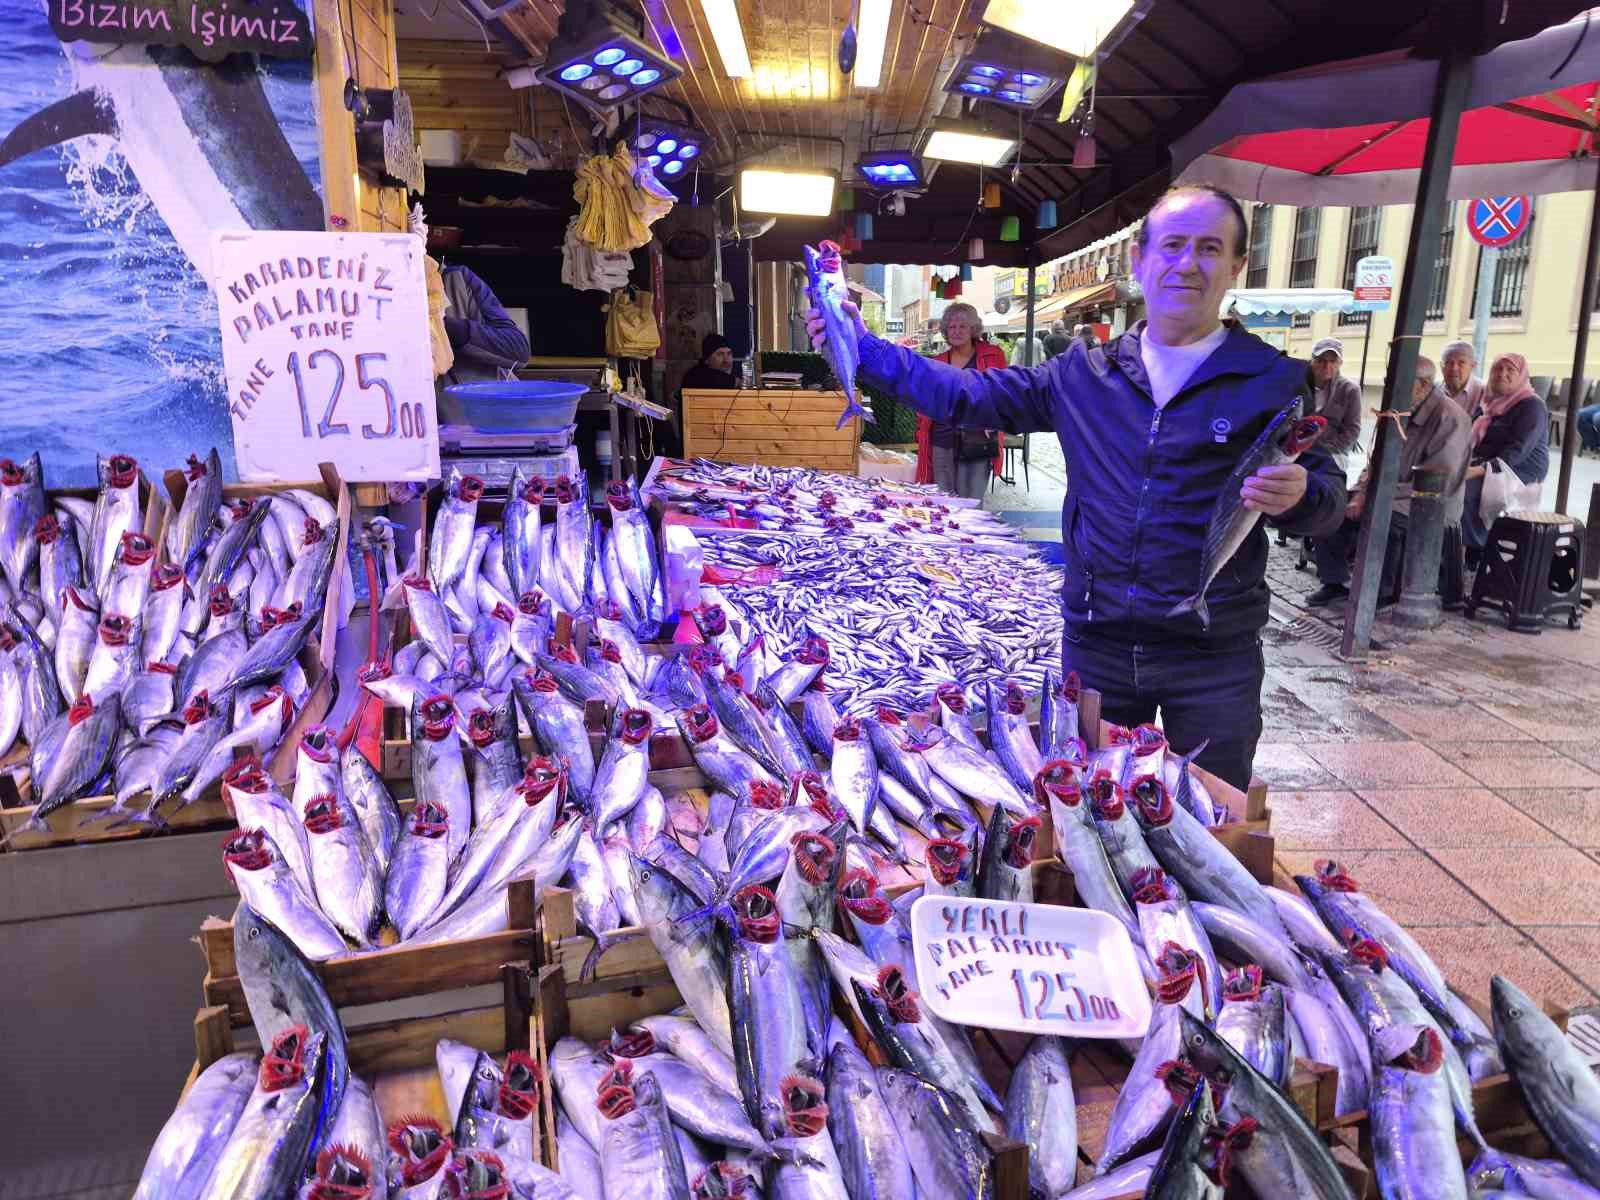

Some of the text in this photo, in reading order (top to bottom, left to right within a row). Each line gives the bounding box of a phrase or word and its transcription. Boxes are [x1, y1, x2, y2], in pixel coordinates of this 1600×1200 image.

[60, 0, 171, 31] Bizim
[233, 287, 393, 344] PALAMUT
[290, 320, 354, 341] TANE
[231, 357, 275, 421] TANE
[927, 935, 1077, 967] PALAMUT
[936, 960, 993, 1001] TANE
